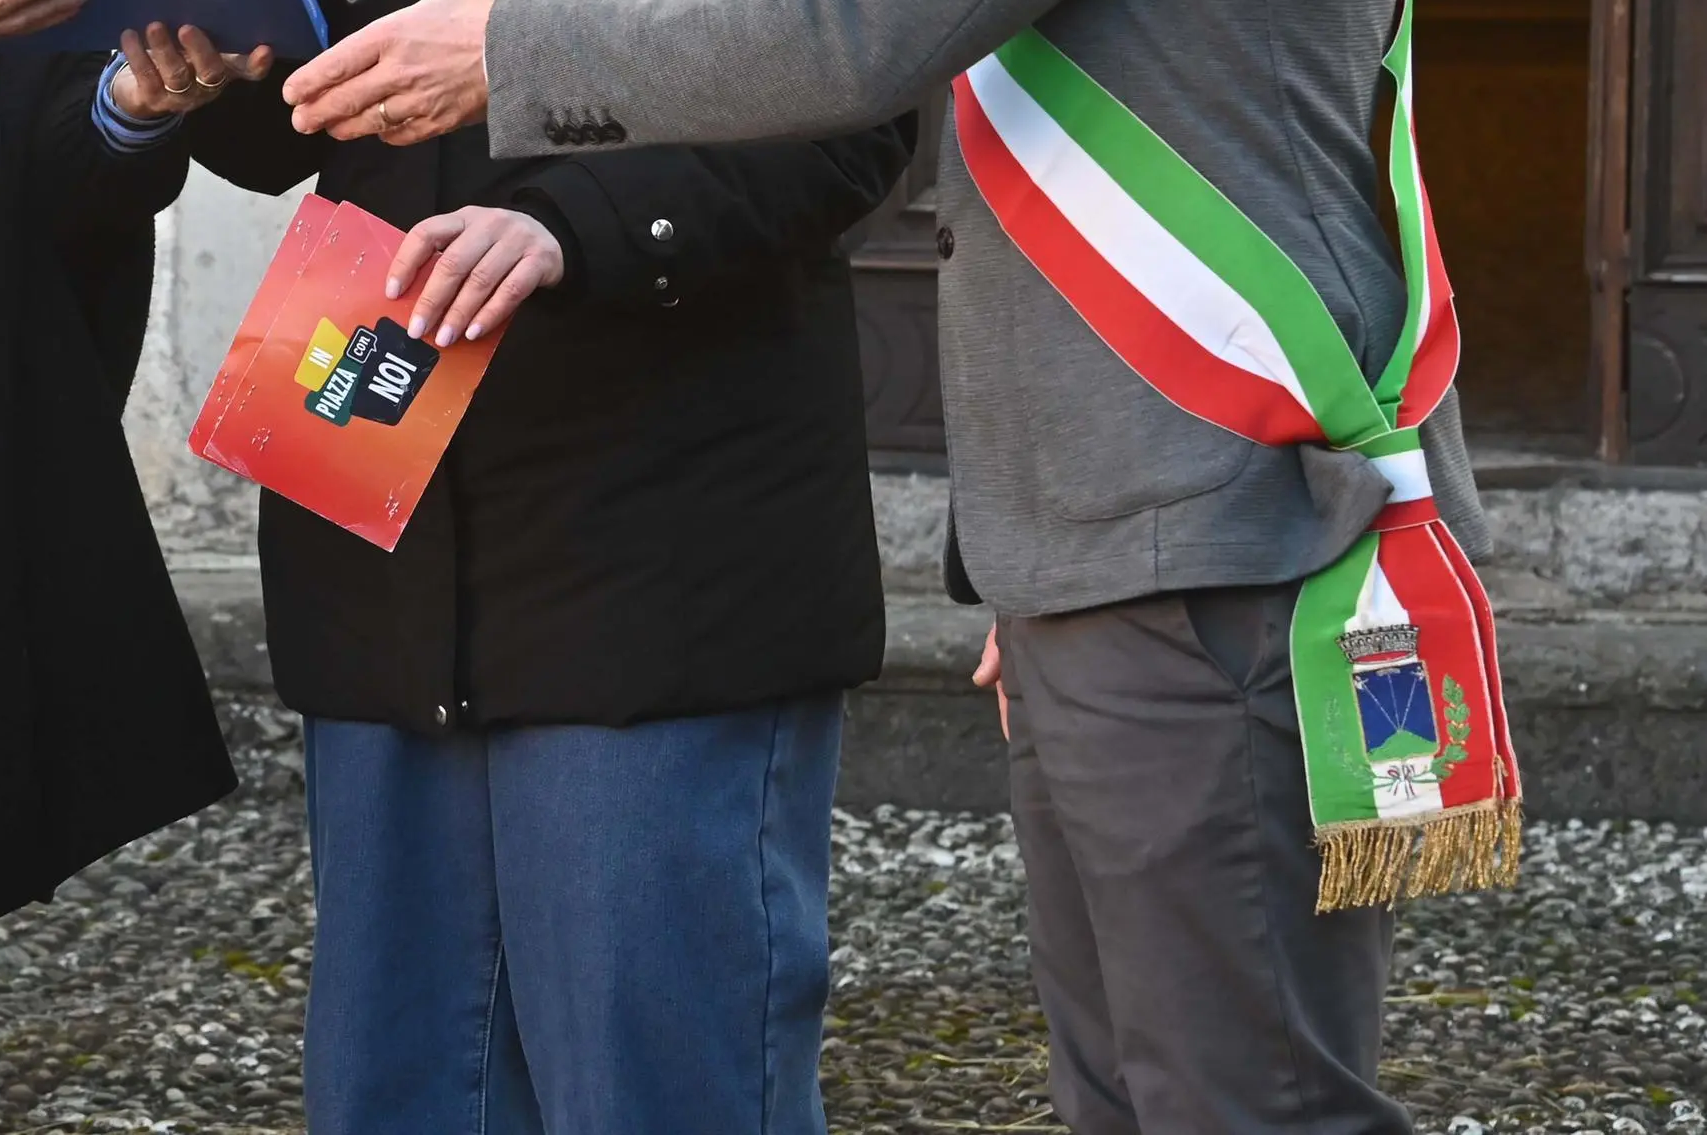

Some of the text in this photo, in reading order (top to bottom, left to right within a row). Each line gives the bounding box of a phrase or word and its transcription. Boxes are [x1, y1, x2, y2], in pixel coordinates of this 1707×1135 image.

[308, 346, 334, 369] IN
[353, 335, 371, 357] con
[315, 367, 358, 419] PIAZZA
[368, 352, 418, 404] NOI
